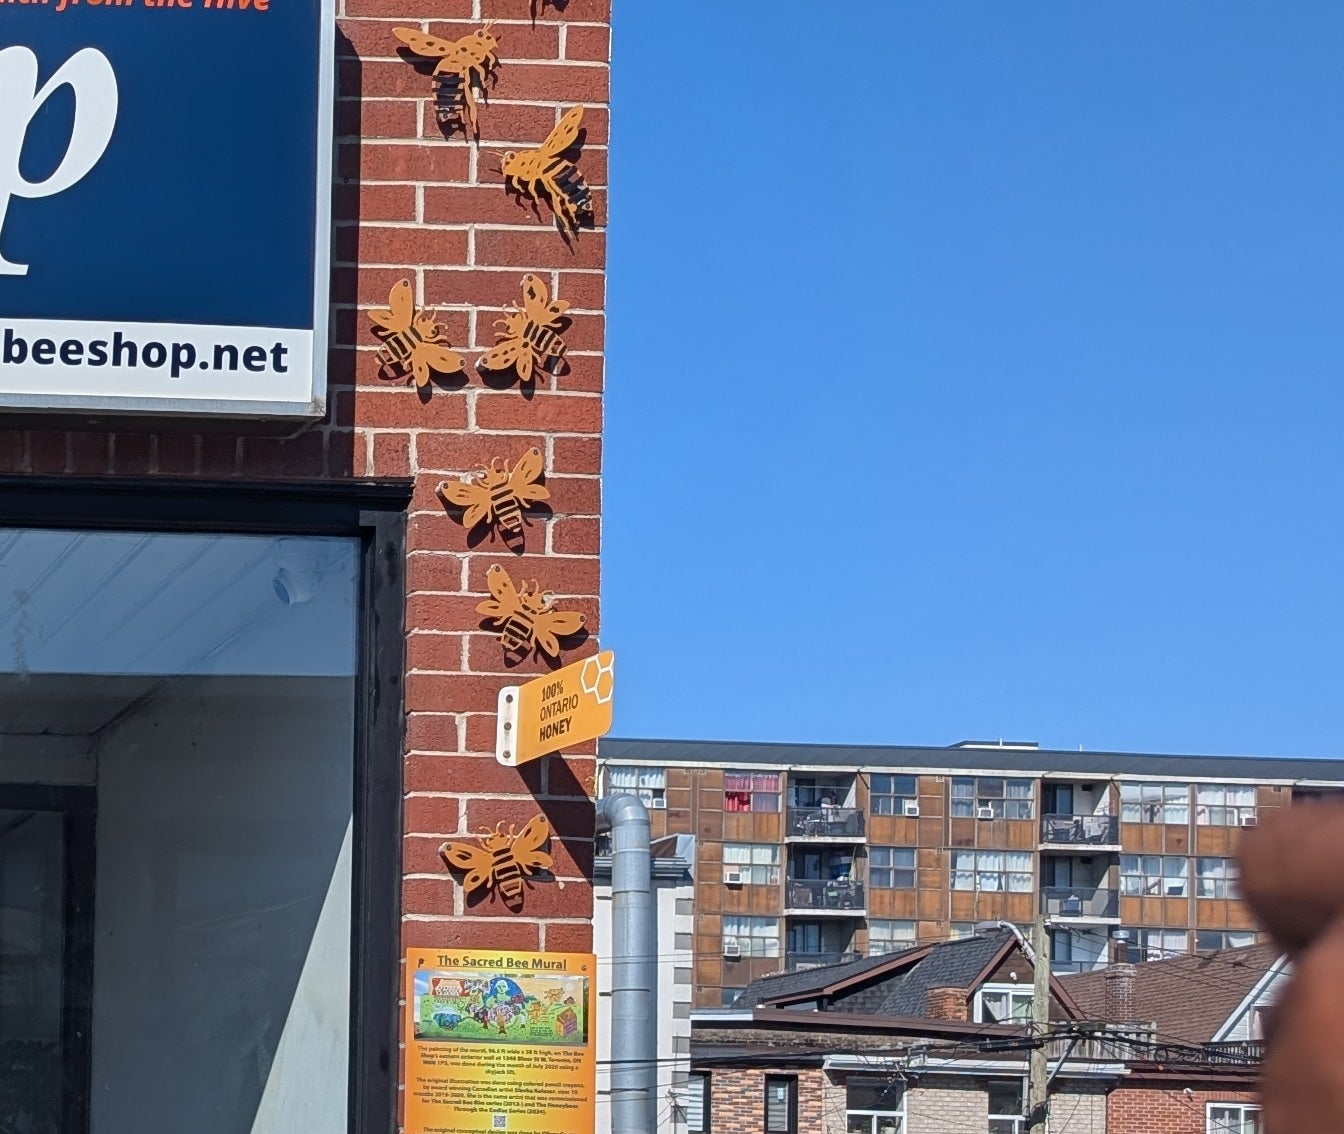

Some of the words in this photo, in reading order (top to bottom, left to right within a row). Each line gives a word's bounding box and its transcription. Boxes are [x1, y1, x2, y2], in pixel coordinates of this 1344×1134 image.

[541, 679, 564, 702] 100%
[540, 693, 579, 722] ONTARIO
[539, 716, 572, 742] HONEY
[437, 955, 459, 967] The
[462, 956, 503, 968] Sacred
[506, 957, 528, 969] Bee
[531, 958, 567, 970] Mural
